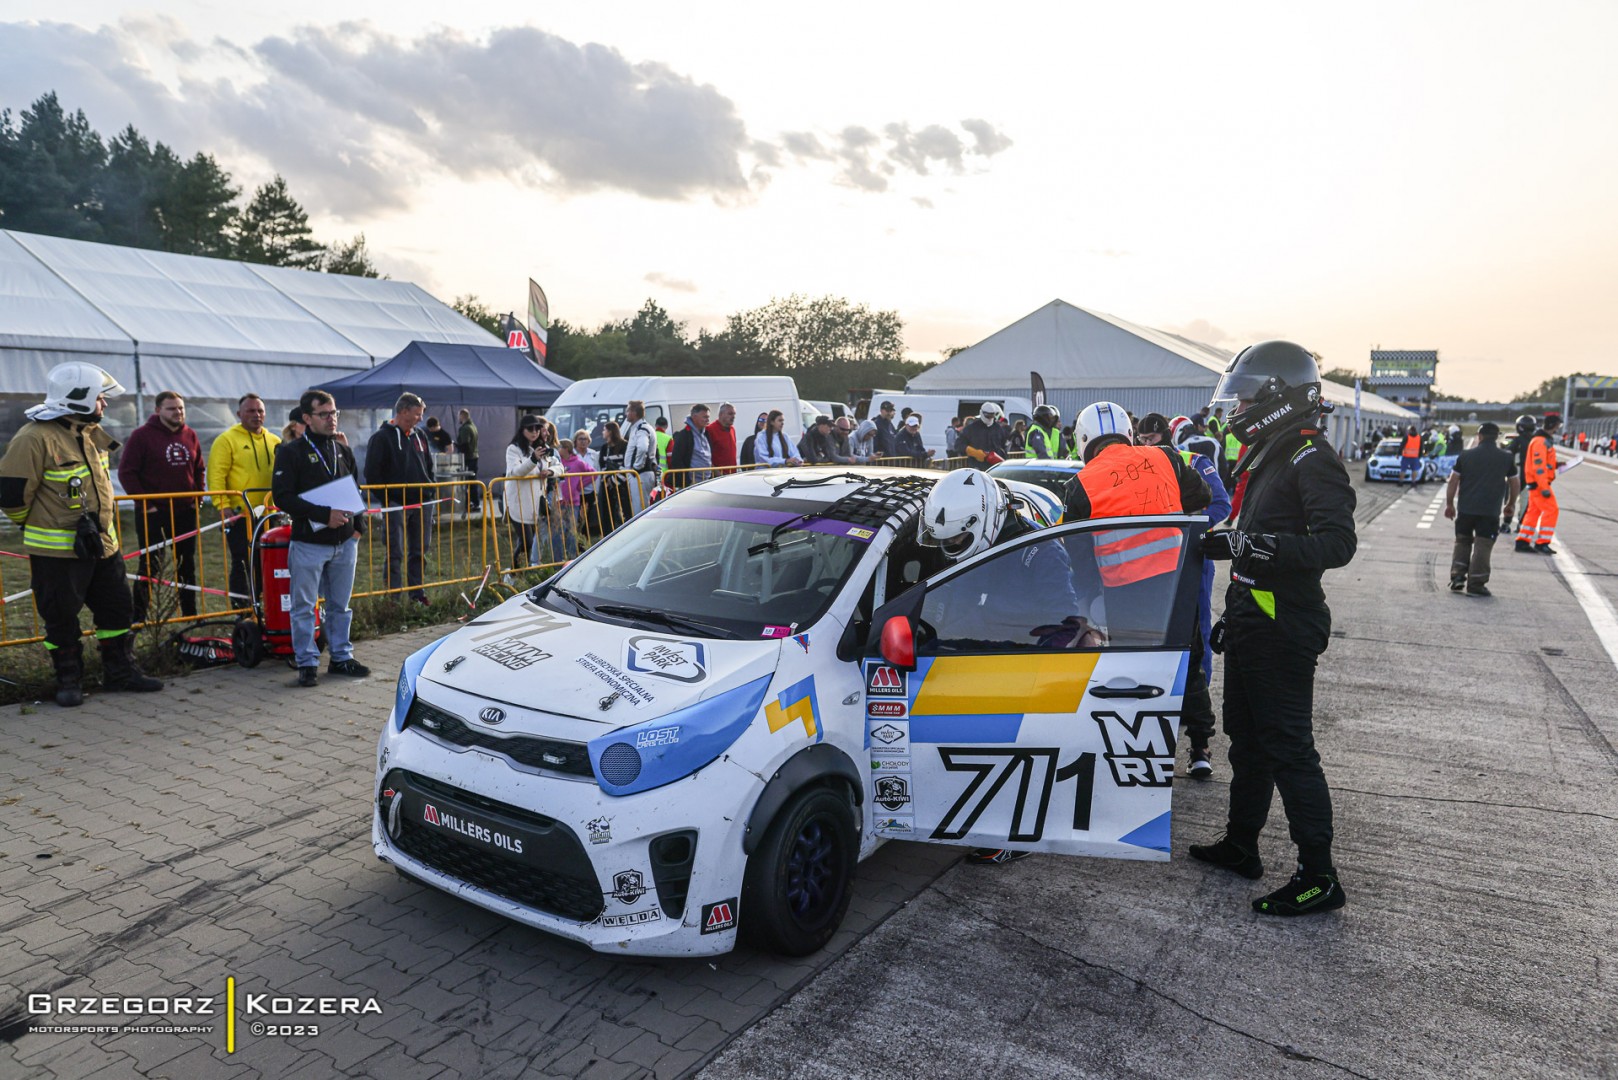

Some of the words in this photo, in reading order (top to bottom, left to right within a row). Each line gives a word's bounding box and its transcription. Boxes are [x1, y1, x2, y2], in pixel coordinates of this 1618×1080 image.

[1263, 403, 1293, 426] KIWAK
[471, 644, 530, 671] RACING
[641, 651, 675, 670] PARK
[652, 644, 689, 668] INVEST
[482, 709, 501, 721] KIA
[637, 726, 680, 744] LOST
[929, 746, 1096, 842] 711
[441, 812, 492, 843] MILLERS
[494, 832, 523, 854] OILS
